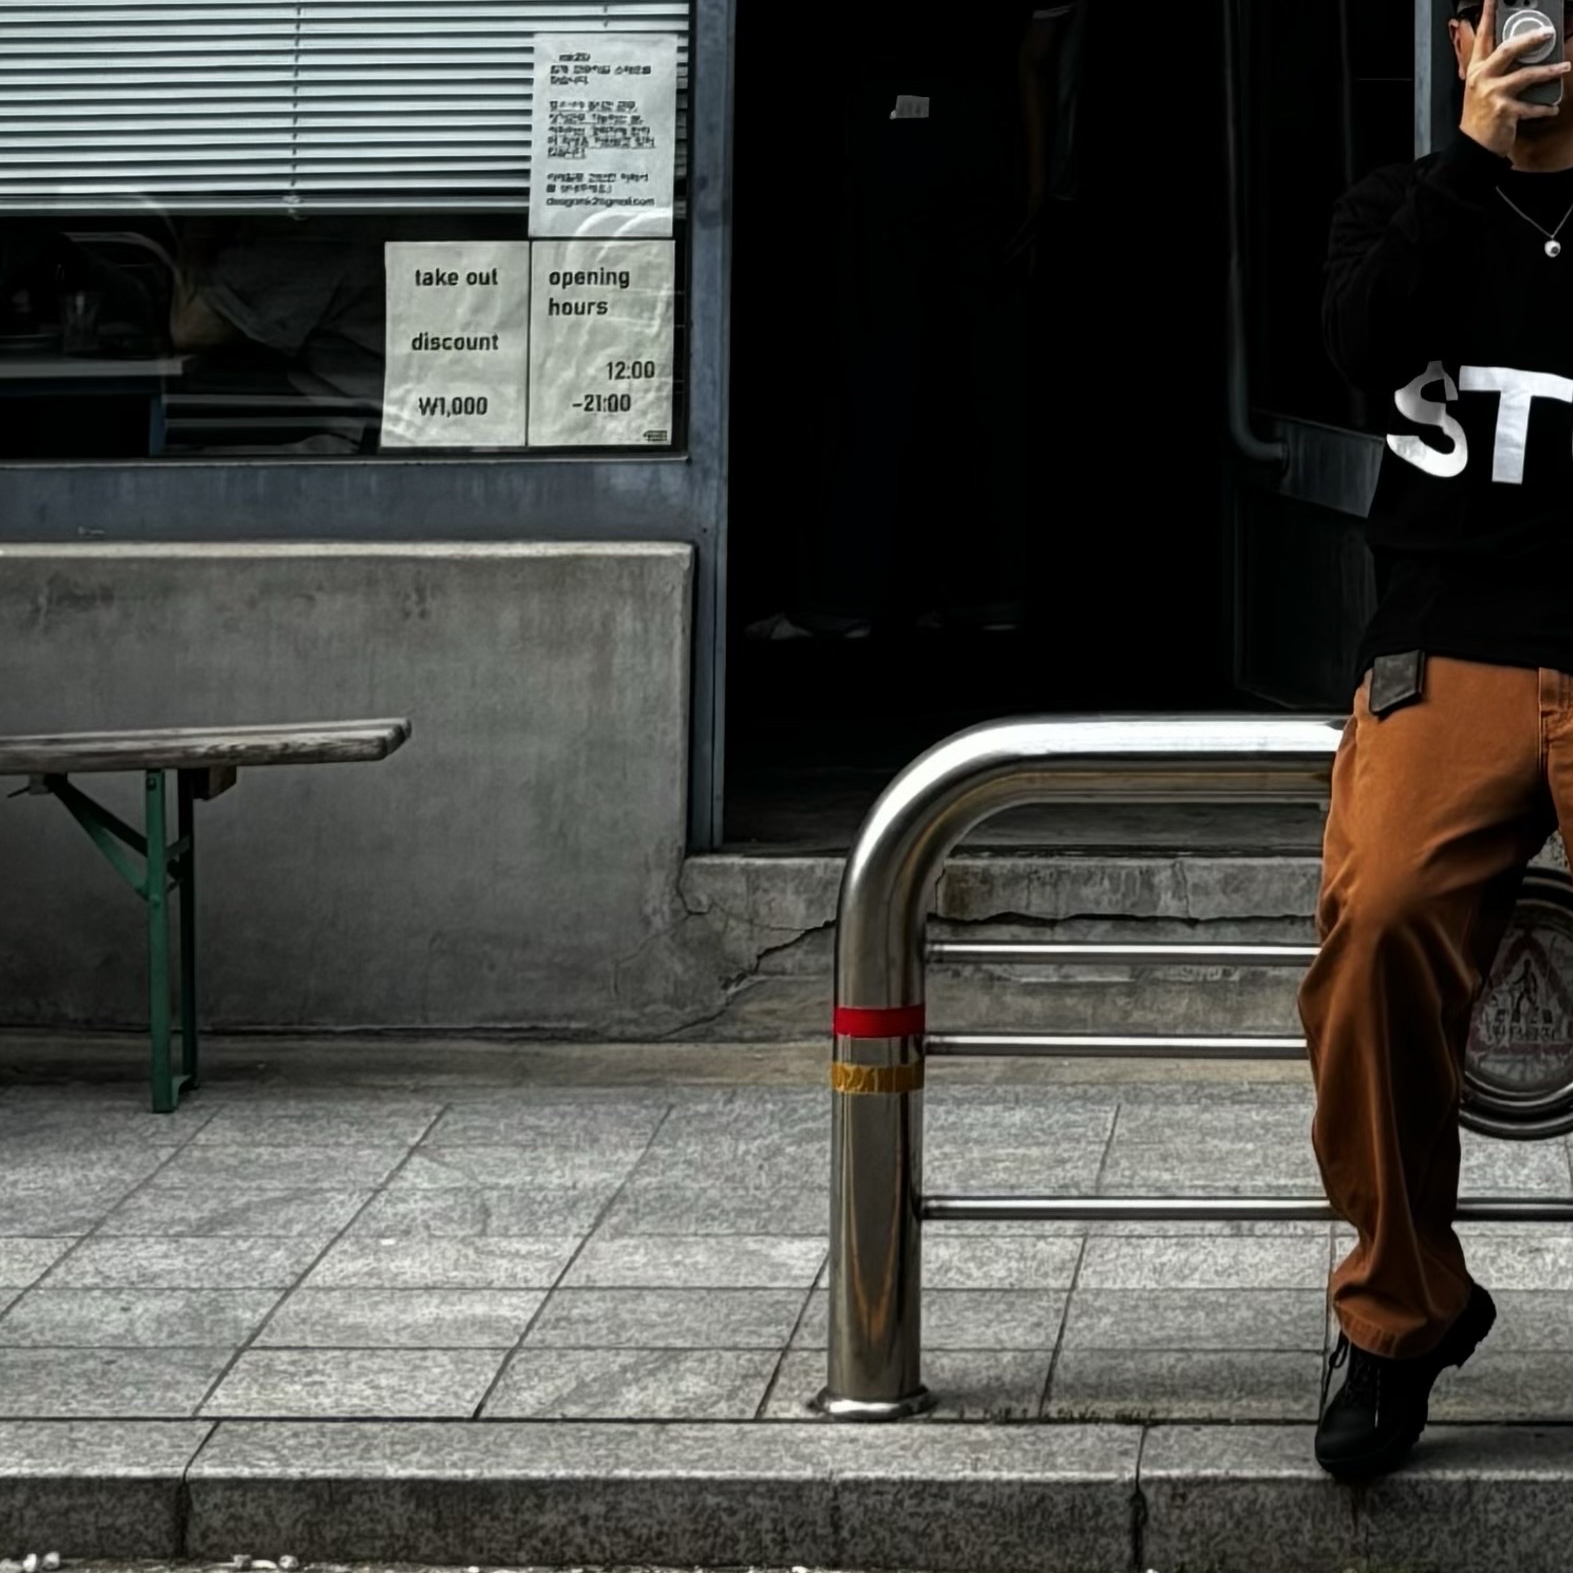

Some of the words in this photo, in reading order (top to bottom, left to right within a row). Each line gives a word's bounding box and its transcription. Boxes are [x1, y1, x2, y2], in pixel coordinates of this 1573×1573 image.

[415, 268, 459, 287] take
[466, 267, 498, 287] out
[549, 267, 630, 290] opening
[548, 297, 608, 317] hours
[411, 331, 499, 351] discount
[606, 360, 655, 380] 12:00
